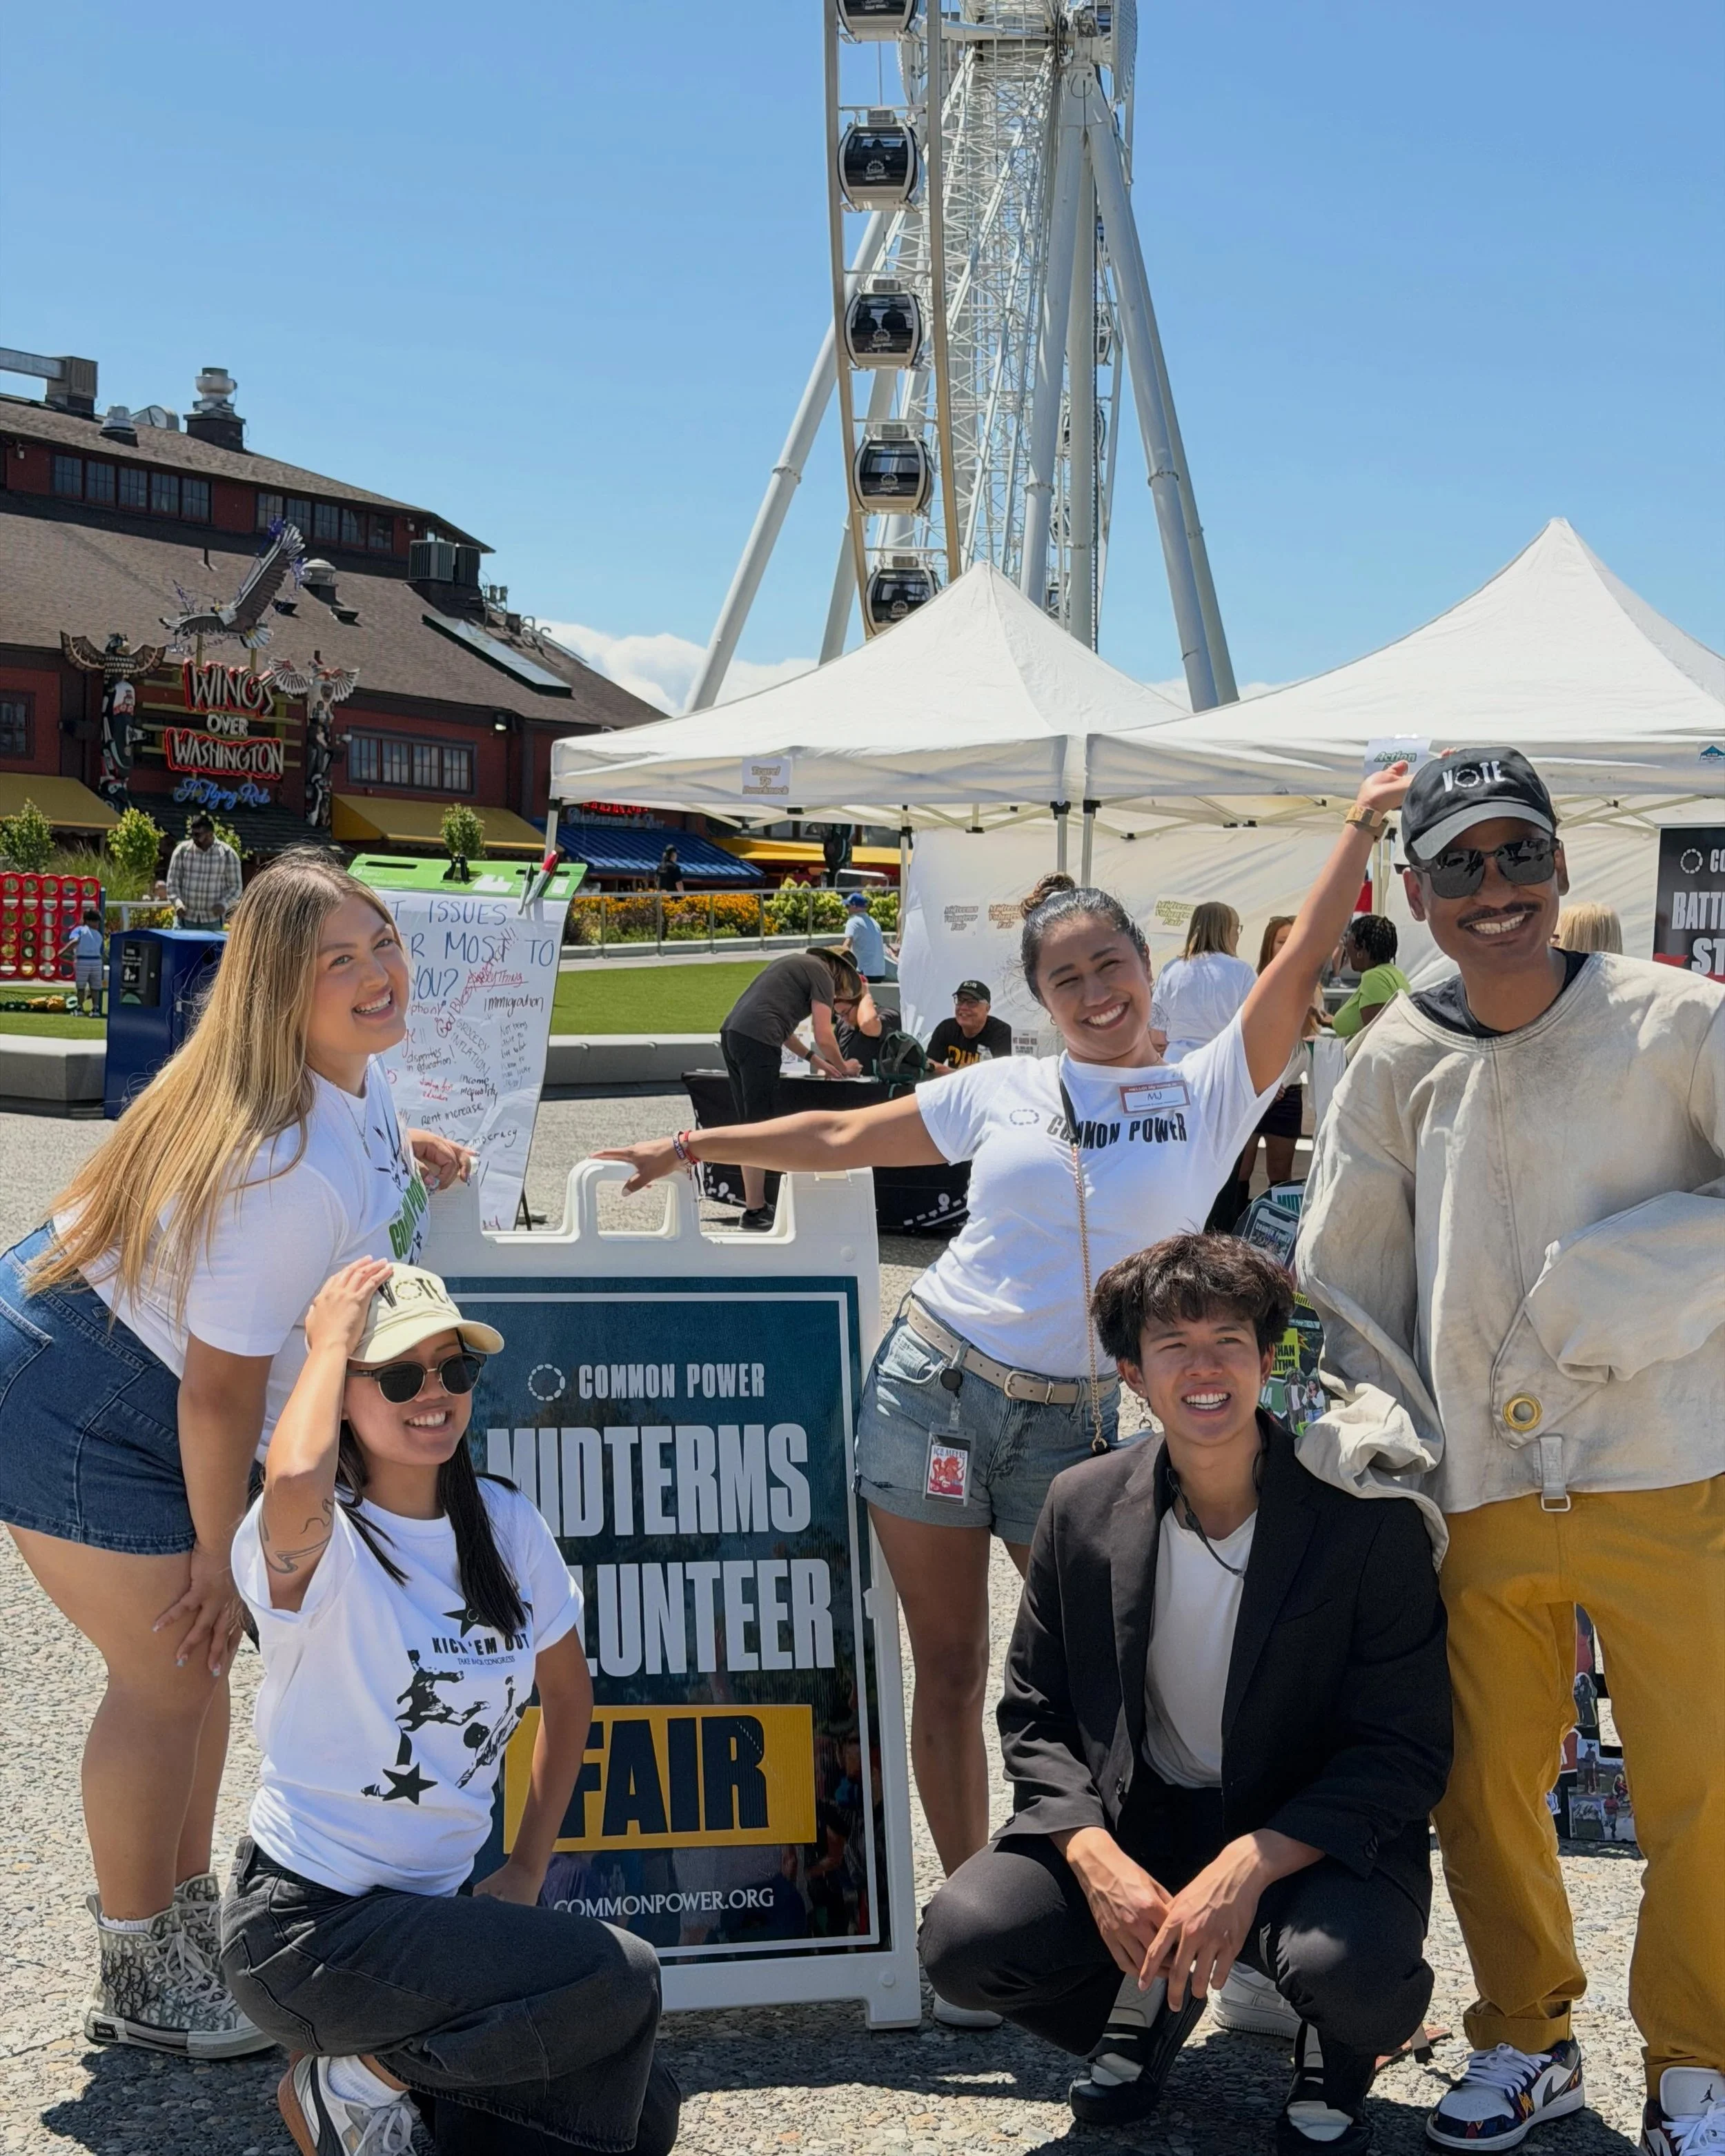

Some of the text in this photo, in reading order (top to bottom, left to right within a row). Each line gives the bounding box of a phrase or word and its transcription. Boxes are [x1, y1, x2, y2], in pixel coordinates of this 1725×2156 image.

[184, 658, 276, 718] WINGS
[207, 714, 248, 736] OVER
[166, 728, 284, 779] WASHINGTON
[1374, 751, 1417, 762] Action
[1442, 761, 1506, 792] VOTE
[196, 778, 237, 810] Flying
[239, 782, 270, 807] Ride
[429, 900, 507, 925] ISSUES
[445, 931, 511, 963] MOST
[525, 939, 555, 967] TO
[1147, 1091, 1162, 1101] MJ
[1129, 1113, 1187, 1143] POWER
[578, 1363, 765, 1400] COMMON POWER
[486, 1423, 811, 1538] MIDTERMS
[567, 1558, 836, 1678] UNTEER
[432, 1637, 469, 1654] KICK
[504, 1633, 530, 1651] OUT
[484, 1656, 515, 1665] CONGRESS
[559, 1714, 770, 1839] FAIR
[554, 1888, 774, 1918] COMMONPOWER.ORG
